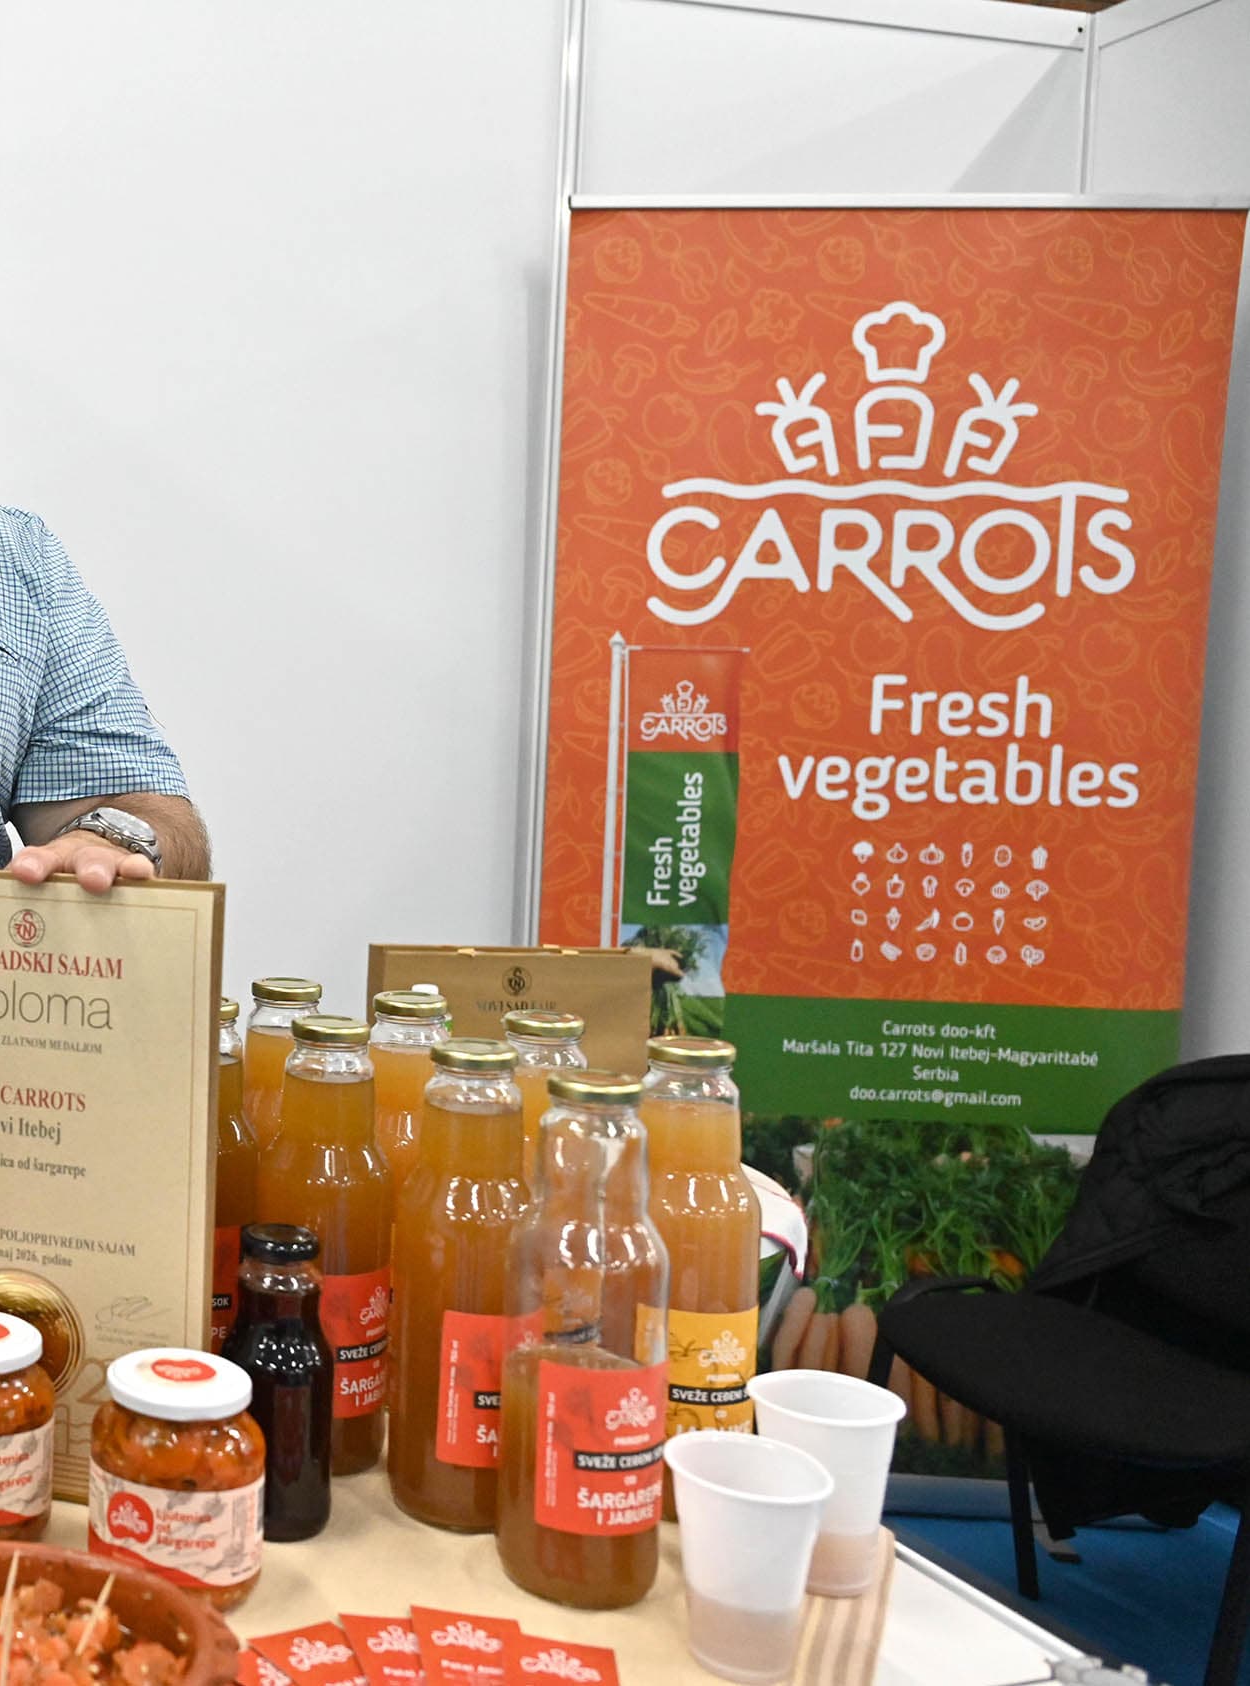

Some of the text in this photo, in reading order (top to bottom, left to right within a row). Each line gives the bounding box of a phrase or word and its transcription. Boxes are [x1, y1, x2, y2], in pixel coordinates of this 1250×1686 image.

[646, 482, 1136, 631] CARROTS
[869, 674, 1053, 738] Fresh
[640, 713, 727, 742] CARROTS
[777, 743, 1140, 820] vegetables
[676, 772, 707, 906] vegetables
[646, 836, 673, 906] Fresh
[57, 952, 124, 979] SAJAM
[882, 1020, 996, 1039] Carrots doo-kft
[1, 1034, 46, 1049] ZLATNOM
[49, 1039, 103, 1054] MEDALJOM
[782, 1039, 841, 1056] Maršala
[846, 1040, 874, 1057] Tita
[880, 1042, 907, 1057] 127
[912, 1044, 945, 1060] Novi
[912, 1065, 960, 1082] Serbia
[0, 1085, 87, 1112] CARROTS
[849, 1085, 1022, 1108] doo.carrots@gmail.com
[18, 1117, 62, 1145] Itebej
[17, 1157, 31, 1170] od
[33, 1157, 87, 1180] šargarepe
[0, 1227, 95, 1253] POLJOPRIVREDNI
[96, 1239, 136, 1257] SAJAM
[41, 1252, 73, 1269] godine
[339, 1345, 369, 1361] SVEŽE
[671, 1387, 709, 1402] SVEŽE
[577, 1451, 617, 1469] SVEŽE
